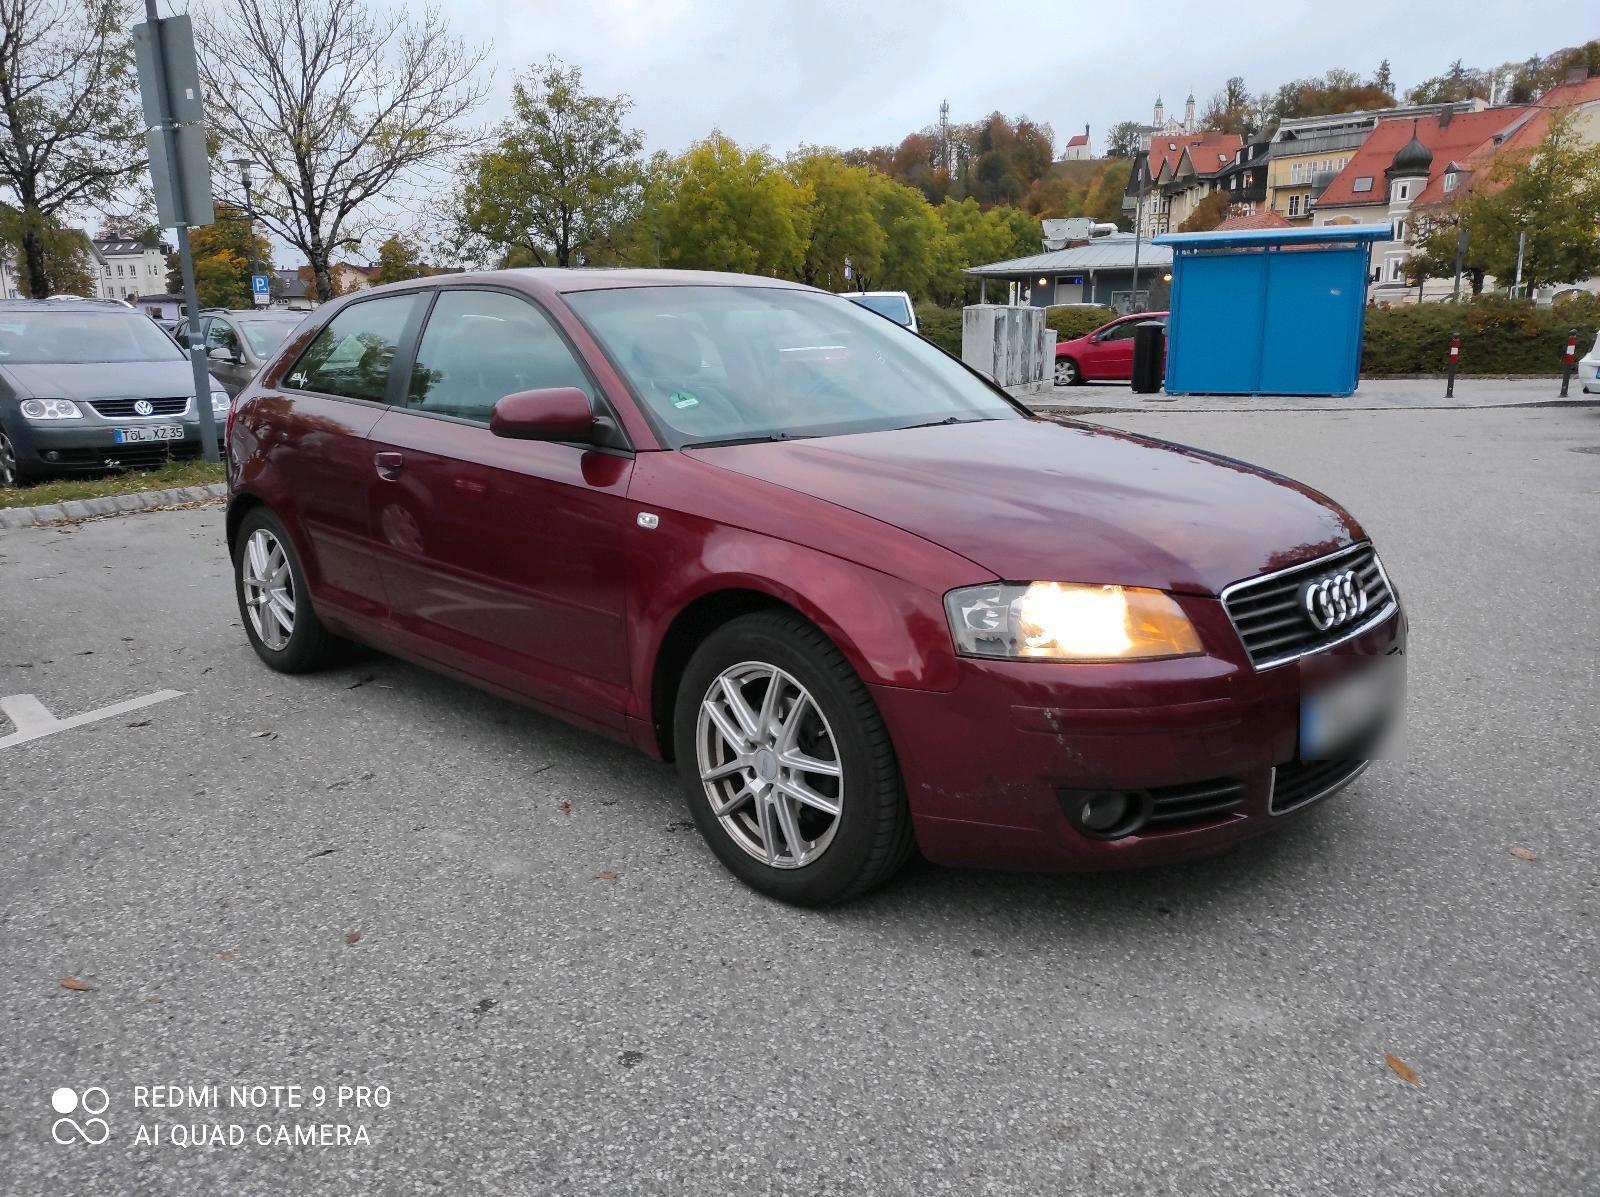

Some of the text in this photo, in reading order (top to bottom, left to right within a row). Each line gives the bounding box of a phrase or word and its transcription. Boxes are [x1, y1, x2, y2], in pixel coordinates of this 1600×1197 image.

[256, 278, 265, 292] P
[123, 430, 146, 441] TÖL
[153, 428, 167, 439] XZ
[170, 427, 183, 438] 35
